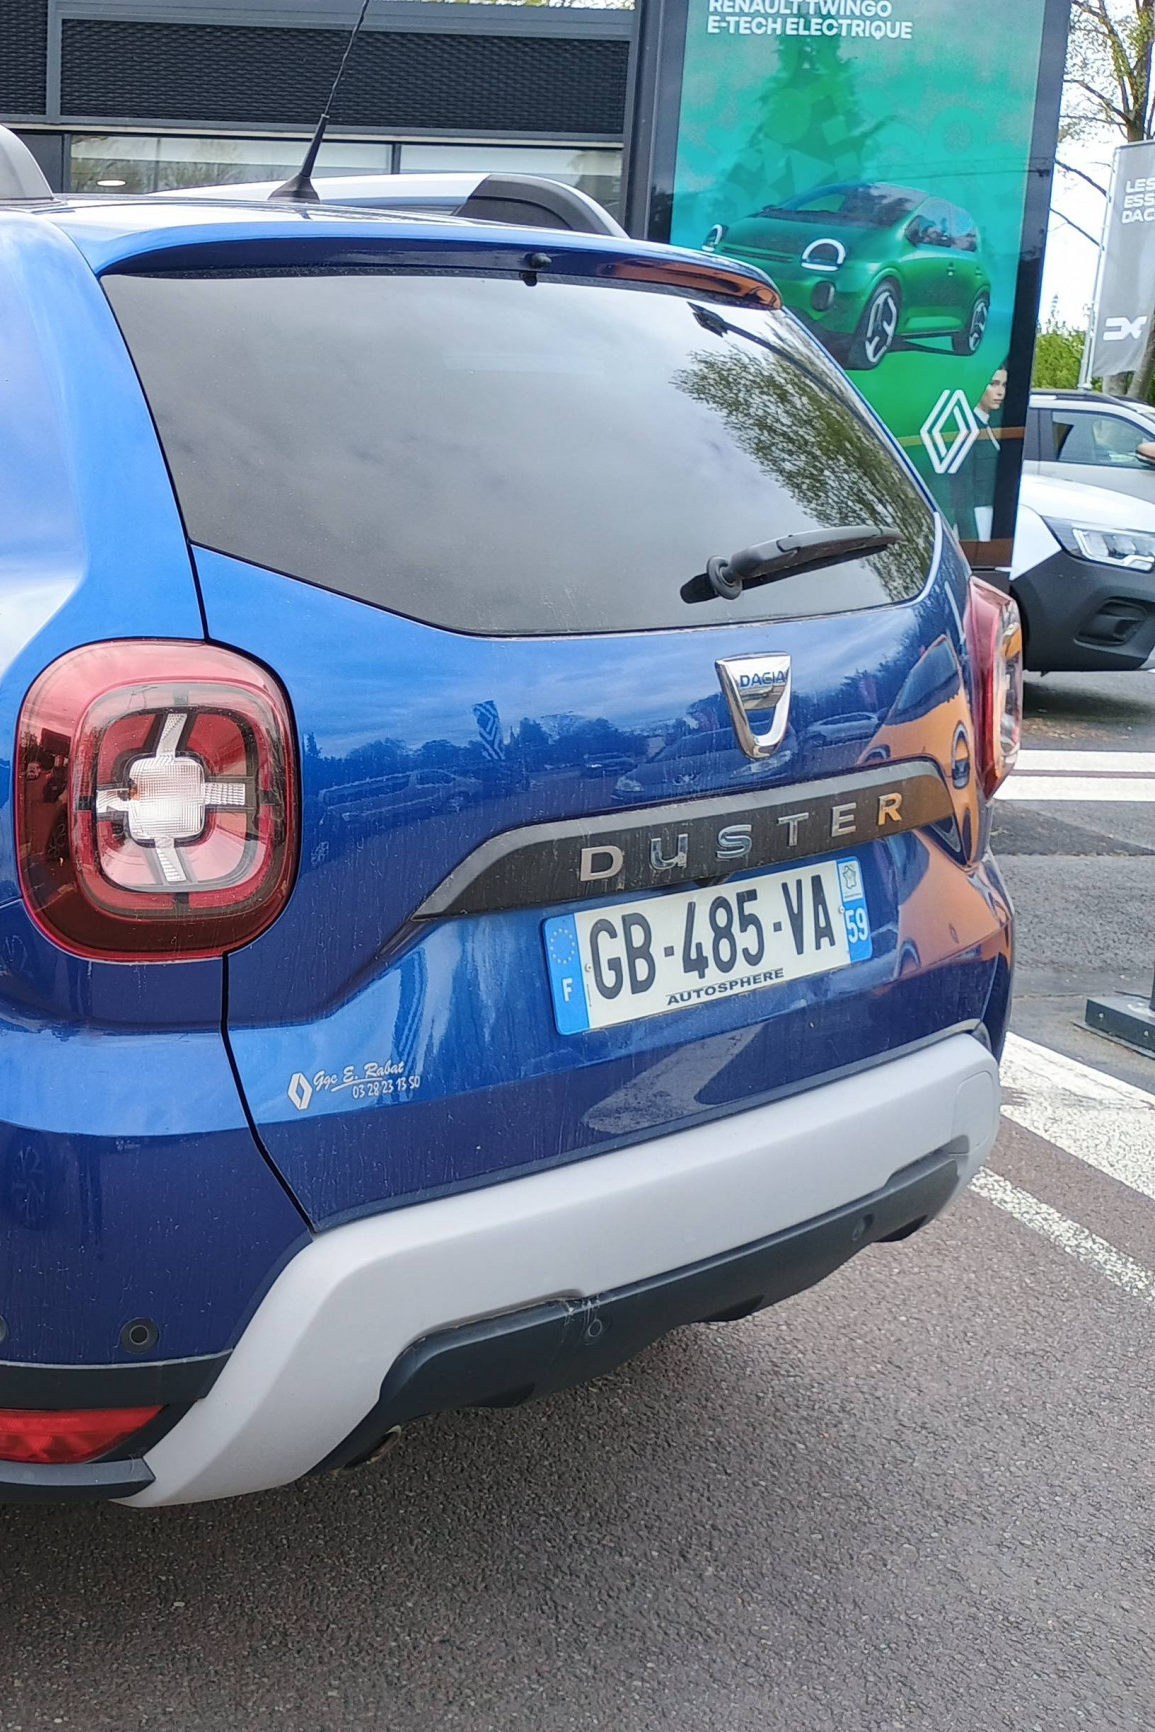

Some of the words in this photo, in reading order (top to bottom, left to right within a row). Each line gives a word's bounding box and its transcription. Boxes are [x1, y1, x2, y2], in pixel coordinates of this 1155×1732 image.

[709, 0, 802, 14] RENAULT
[805, 0, 892, 17] TWINGO
[707, 15, 782, 35] E-TECH
[785, 17, 913, 39] ELECTRIQUE
[739, 670, 787, 688] DACIA
[579, 792, 903, 882] DUSTER
[562, 978, 573, 1002] F
[589, 874, 836, 1000] GB-485-VA
[845, 907, 869, 944] 59
[666, 967, 785, 1006] AUTOSPHERE
[342, 1065, 359, 1083] E.
[363, 1059, 405, 1079] Rabat
[352, 1085, 366, 1099] 03
[367, 1081, 381, 1097] 28
[382, 1079, 394, 1094] 23
[395, 1076, 408, 1092] 13
[409, 1075, 421, 1089] 50
